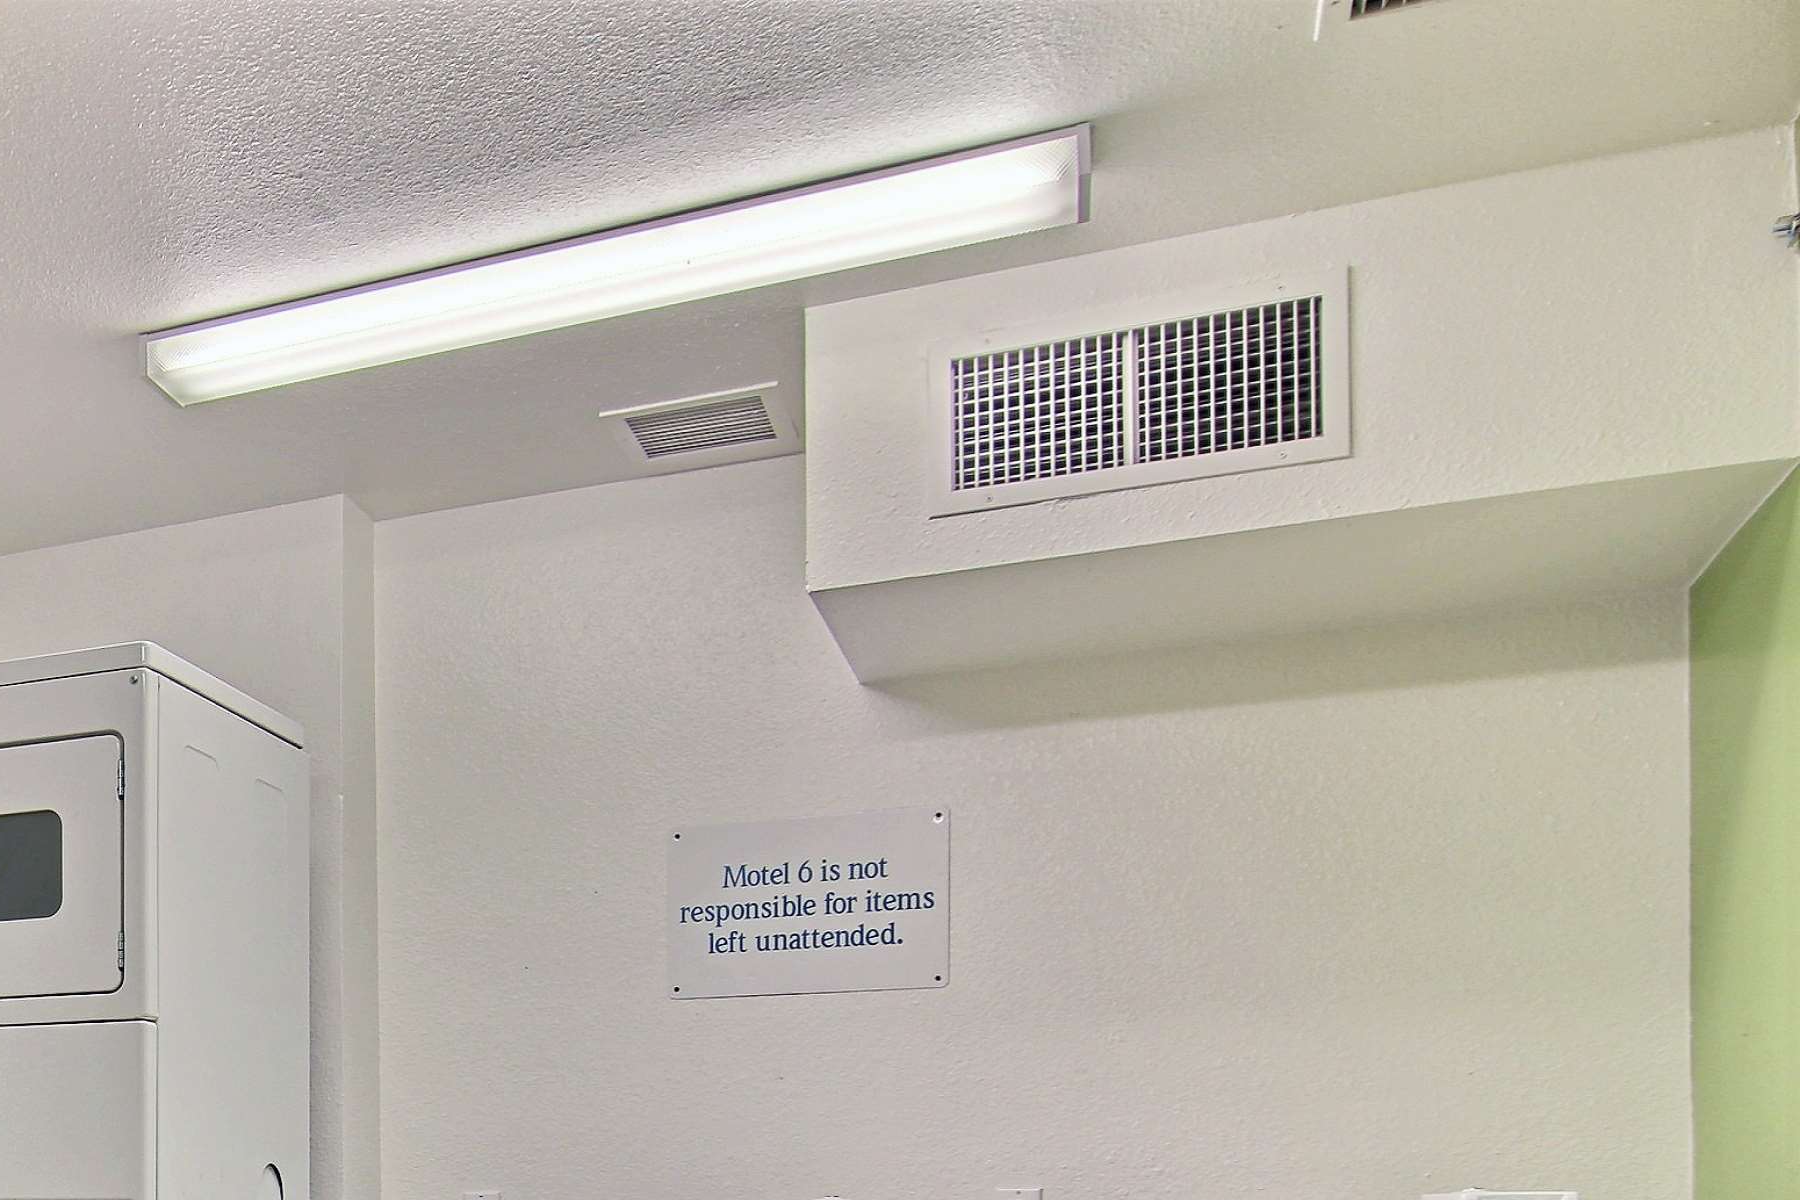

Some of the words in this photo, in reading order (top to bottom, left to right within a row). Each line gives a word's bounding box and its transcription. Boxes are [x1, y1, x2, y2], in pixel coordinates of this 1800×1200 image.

[722, 862, 790, 889] Motel
[798, 859, 813, 884] 6
[820, 858, 841, 882] is
[848, 857, 888, 880] not
[679, 894, 816, 927] responsible
[823, 892, 858, 915] for
[865, 889, 935, 912] items
[708, 930, 748, 954] left
[755, 922, 904, 952] unattended.
